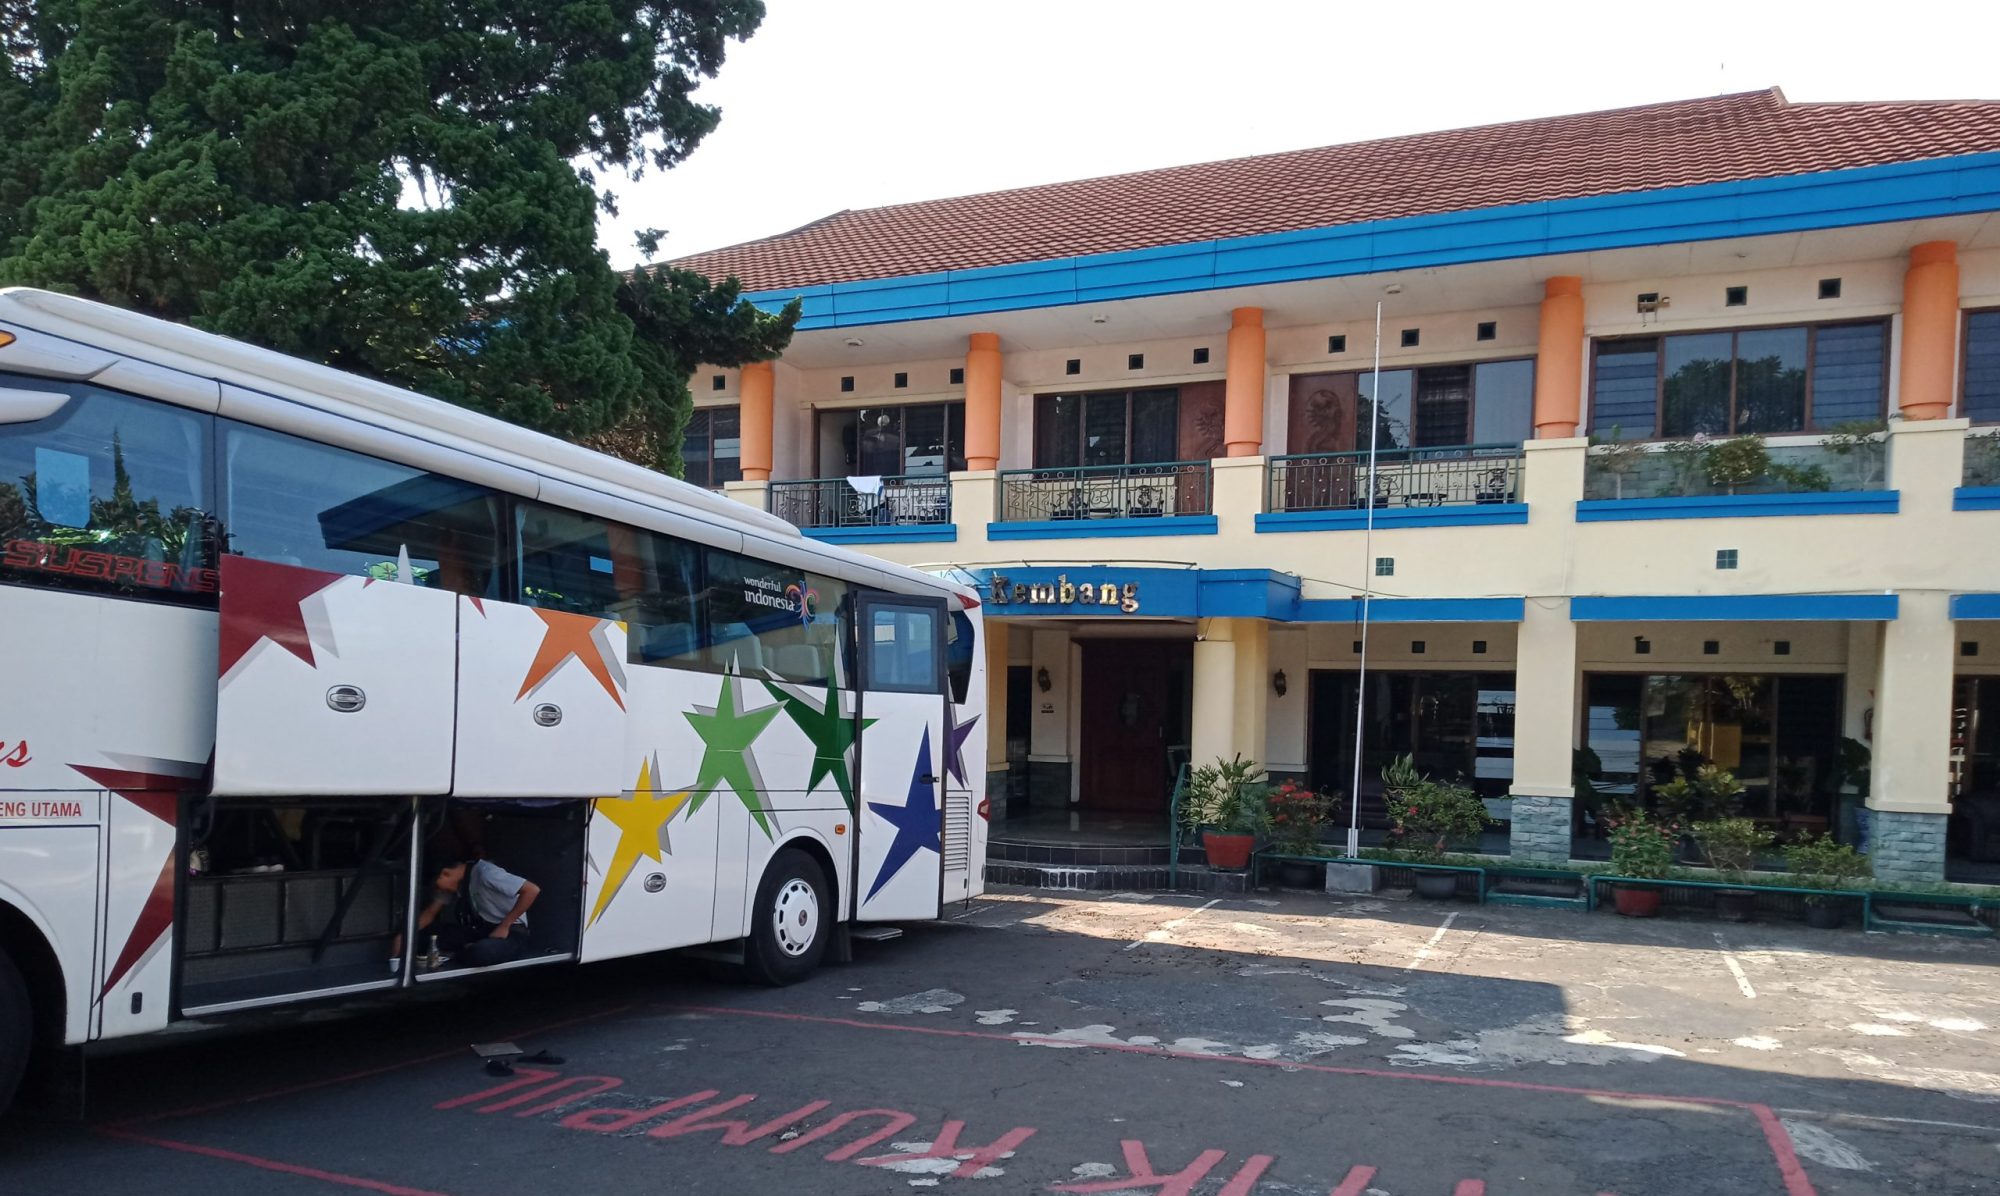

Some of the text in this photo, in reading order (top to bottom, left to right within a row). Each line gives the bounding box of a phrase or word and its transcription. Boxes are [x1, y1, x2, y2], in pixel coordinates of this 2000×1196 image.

[743, 577, 782, 592] wonderful
[989, 572, 1139, 613] Kembang
[31, 802, 82, 817] UTAMA
[435, 1068, 1037, 1178] KUMPUL
